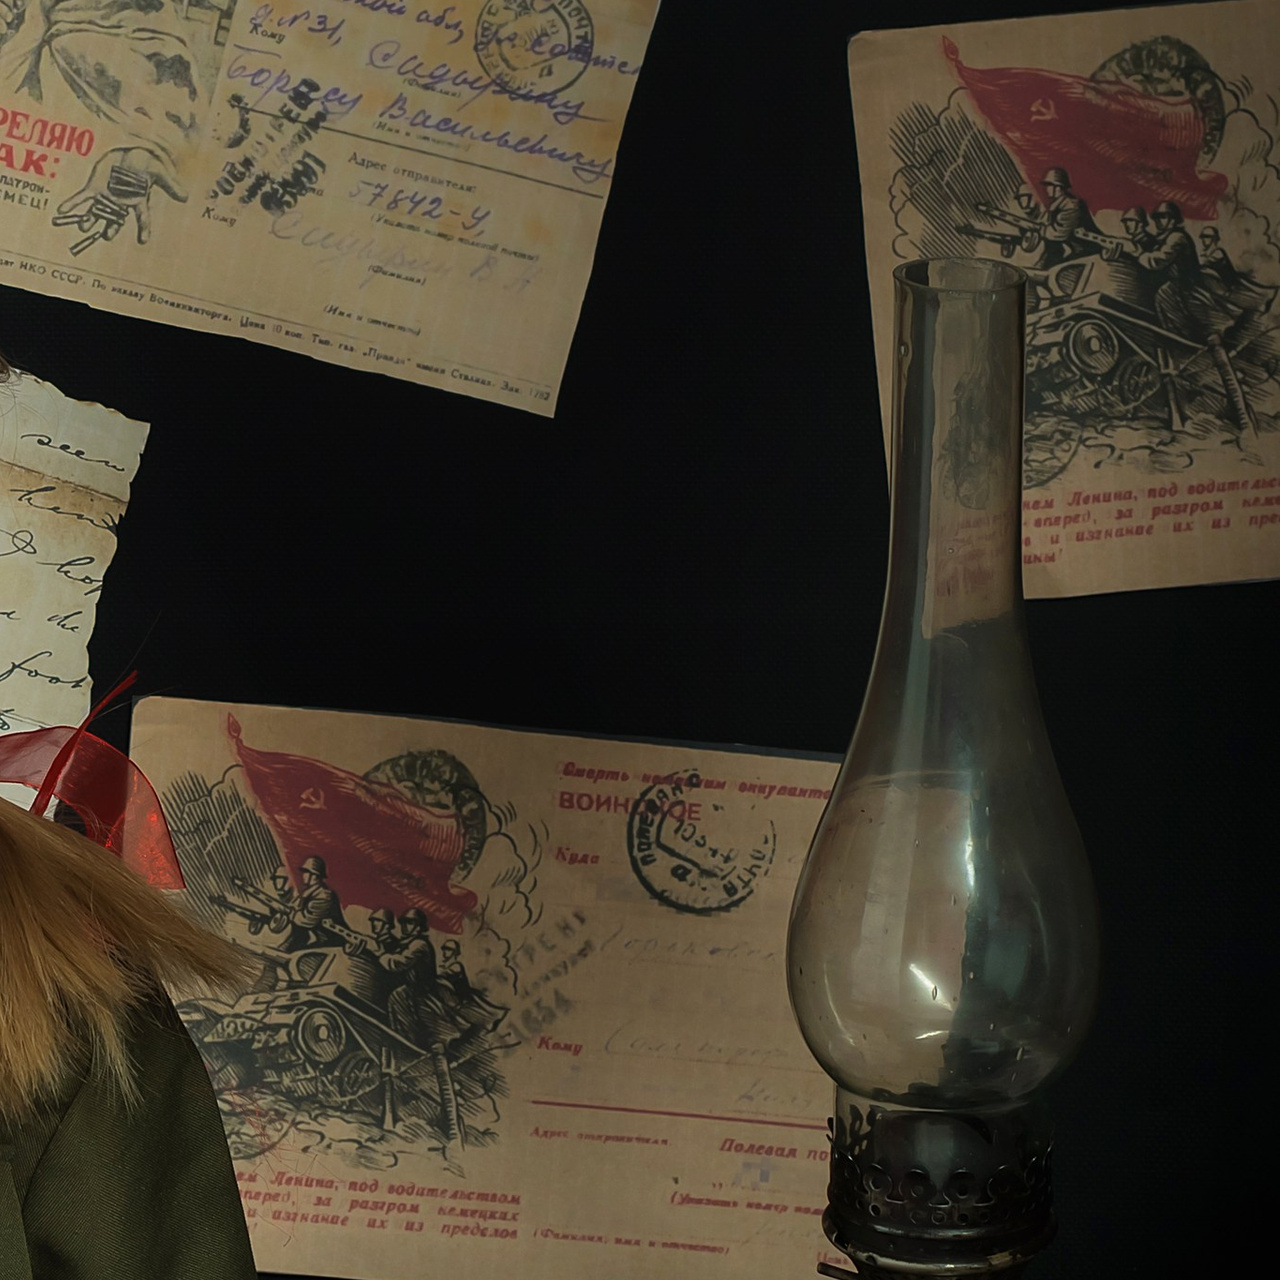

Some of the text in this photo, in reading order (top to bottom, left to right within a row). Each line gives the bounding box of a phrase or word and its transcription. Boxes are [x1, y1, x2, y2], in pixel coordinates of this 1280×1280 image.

[347, 151, 387, 172] Адрес
[0, 174, 51, 194] ПАТРОН-
[19, 260, 47, 275] НКО
[1066, 482, 1178, 507] Ленина, под
[1114, 507, 1133, 520] за
[1151, 499, 1224, 520] разгром
[1050, 517, 1231, 544] и изгнание их из
[558, 791, 702, 821] ВОИНОЕ
[718, 1137, 798, 1159] Полевая
[272, 1170, 521, 1206] Ленина, под водительством
[312, 1195, 519, 1222] за разгром немецких
[271, 1209, 349, 1227] изгнание
[366, 1217, 387, 1230] их
[404, 1220, 425, 1233] из
[440, 1223, 518, 1240] пределов
